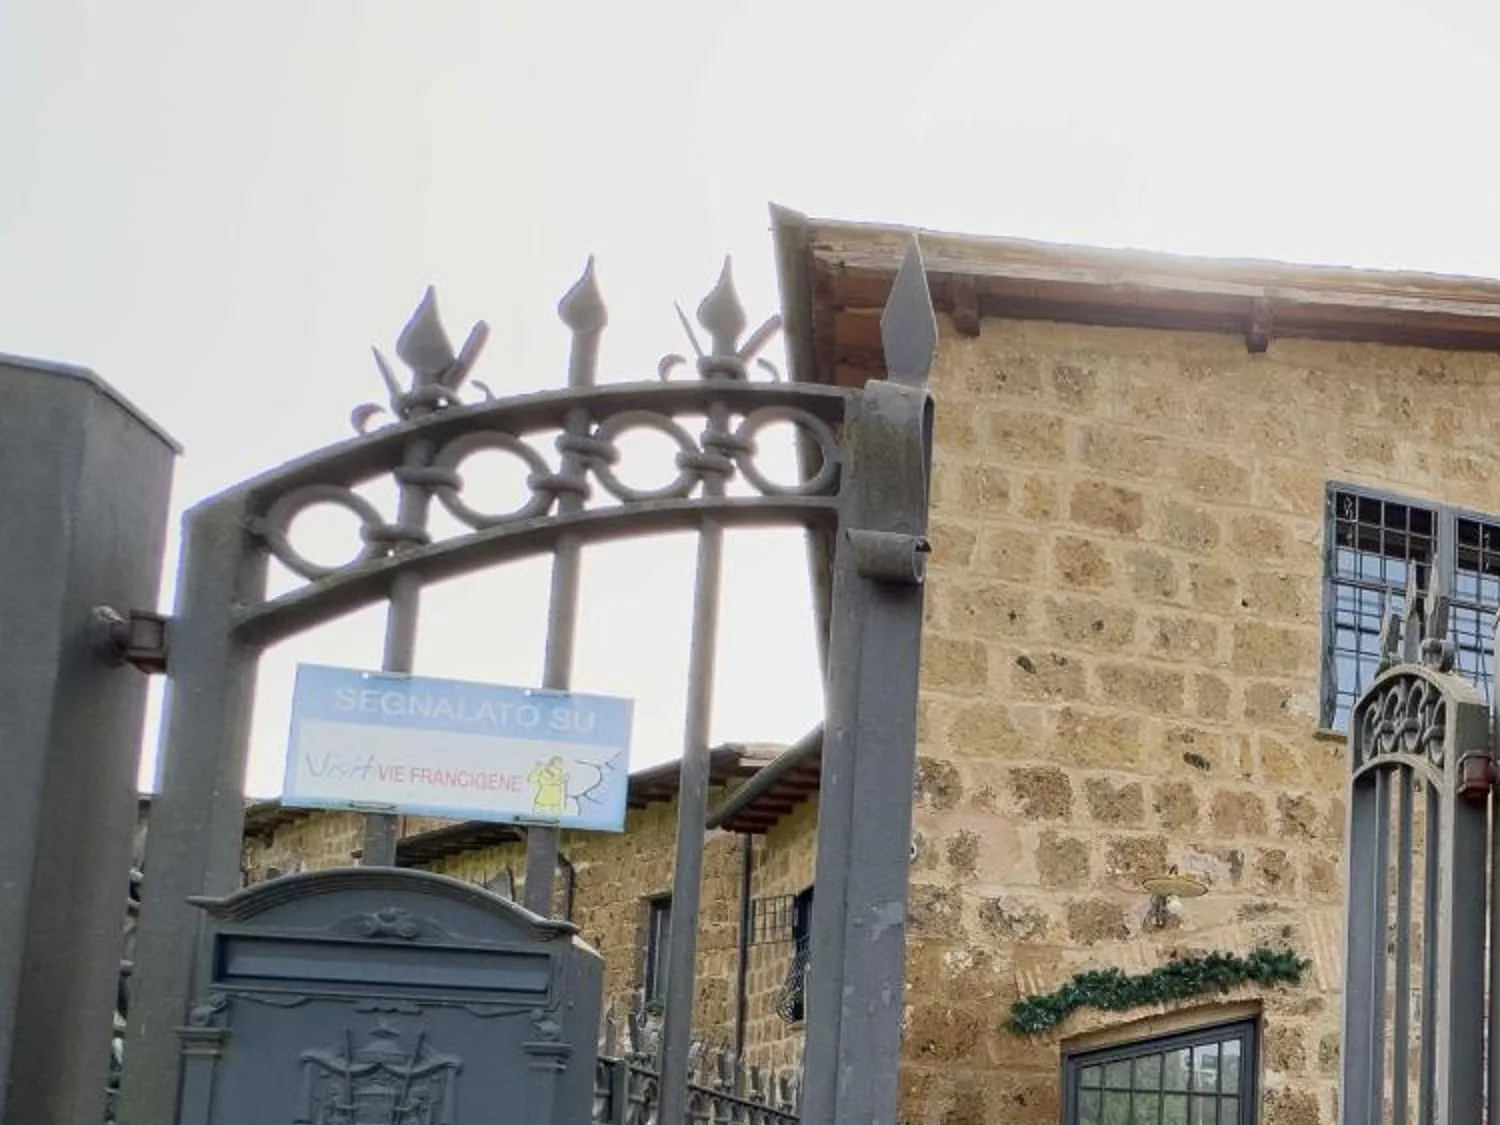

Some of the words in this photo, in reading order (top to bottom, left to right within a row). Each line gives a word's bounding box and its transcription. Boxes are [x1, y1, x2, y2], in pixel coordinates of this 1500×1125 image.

[335, 688, 542, 727] SEGNALATO
[550, 707, 597, 733] SU
[377, 764, 405, 784] VIE
[410, 766, 523, 793] FRANCIGENE
